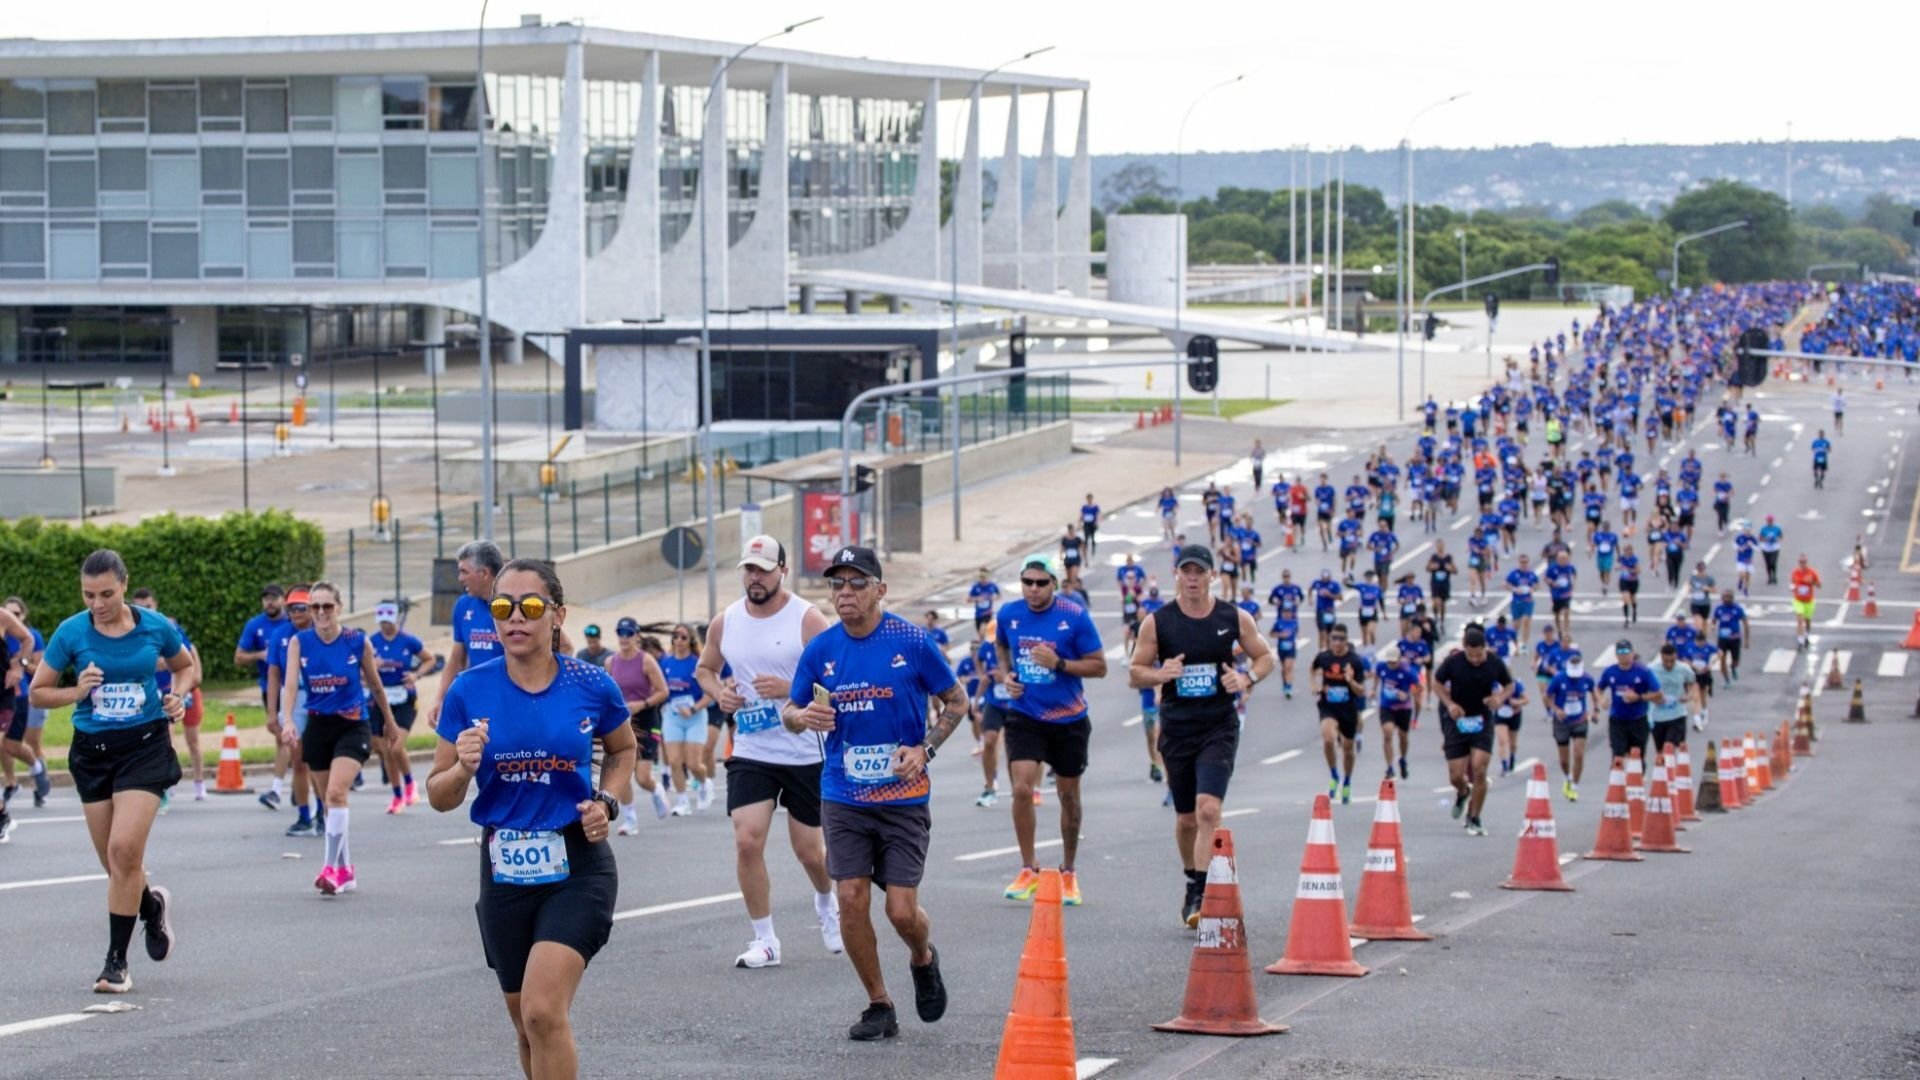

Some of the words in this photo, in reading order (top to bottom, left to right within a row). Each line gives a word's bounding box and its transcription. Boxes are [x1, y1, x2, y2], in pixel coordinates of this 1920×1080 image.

[1181, 676, 1211, 688] 2048
[103, 697, 136, 709] 5772
[838, 700, 875, 713] CAIXA
[741, 709, 768, 725] 1771
[494, 749, 532, 760] circuito
[534, 749, 548, 758] de
[854, 747, 884, 755] CAIXA
[496, 754, 577, 773] corridas
[854, 757, 890, 771] 6767
[500, 770, 551, 785] CAIXA
[500, 831, 540, 841] CAIXA
[501, 845, 551, 866] 5601
[1301, 881, 1338, 891] SENADO
